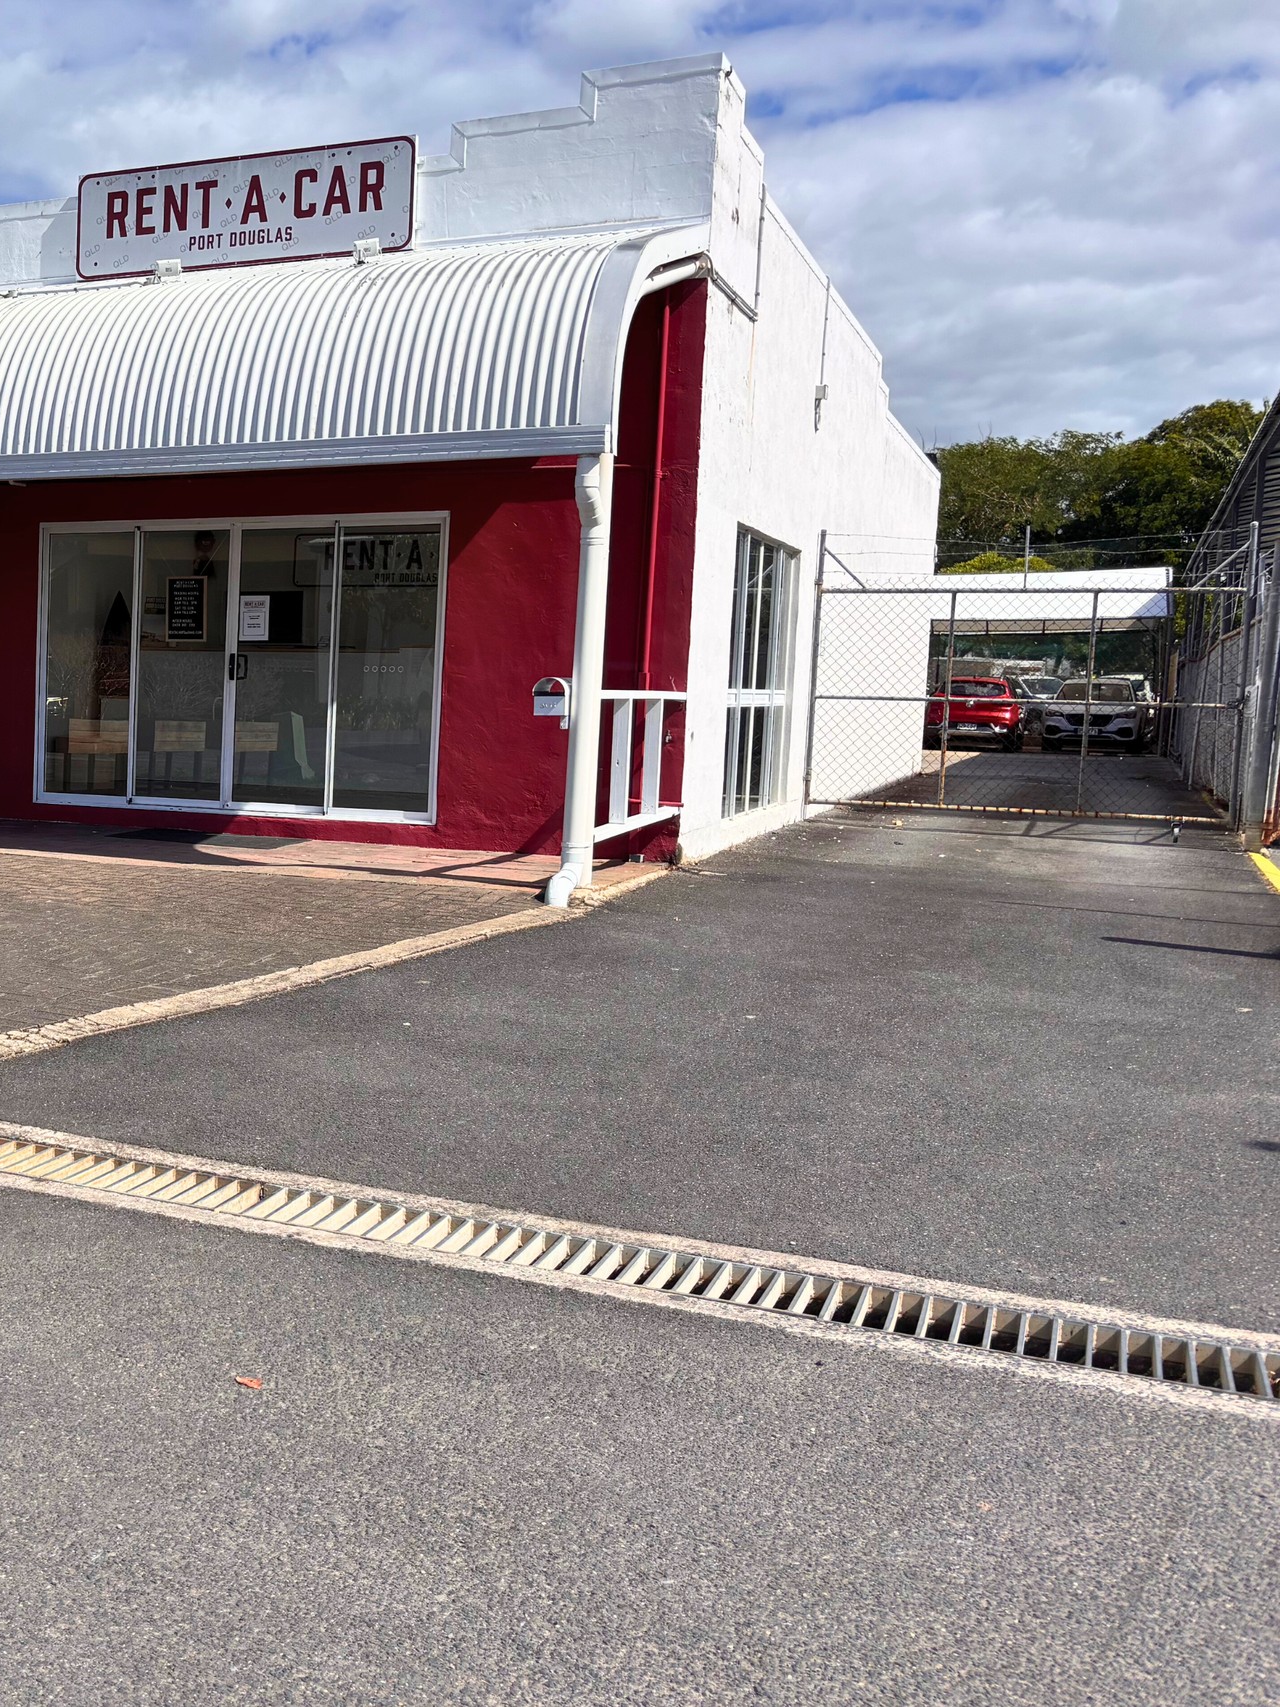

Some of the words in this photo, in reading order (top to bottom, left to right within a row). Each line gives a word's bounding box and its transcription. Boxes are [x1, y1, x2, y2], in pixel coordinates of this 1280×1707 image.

[106, 179, 218, 239] RENT
[240, 174, 268, 225] A
[294, 161, 384, 219] CAR
[220, 213, 238, 228] QLD
[189, 233, 224, 251] PORT
[229, 226, 293, 248] DOUGLAS
[357, 225, 376, 240] QLD
[84, 244, 101, 258] QLD
[113, 254, 130, 269] QLD
[406, 539, 423, 570] A
[399, 572, 438, 583] DOUGLAS
